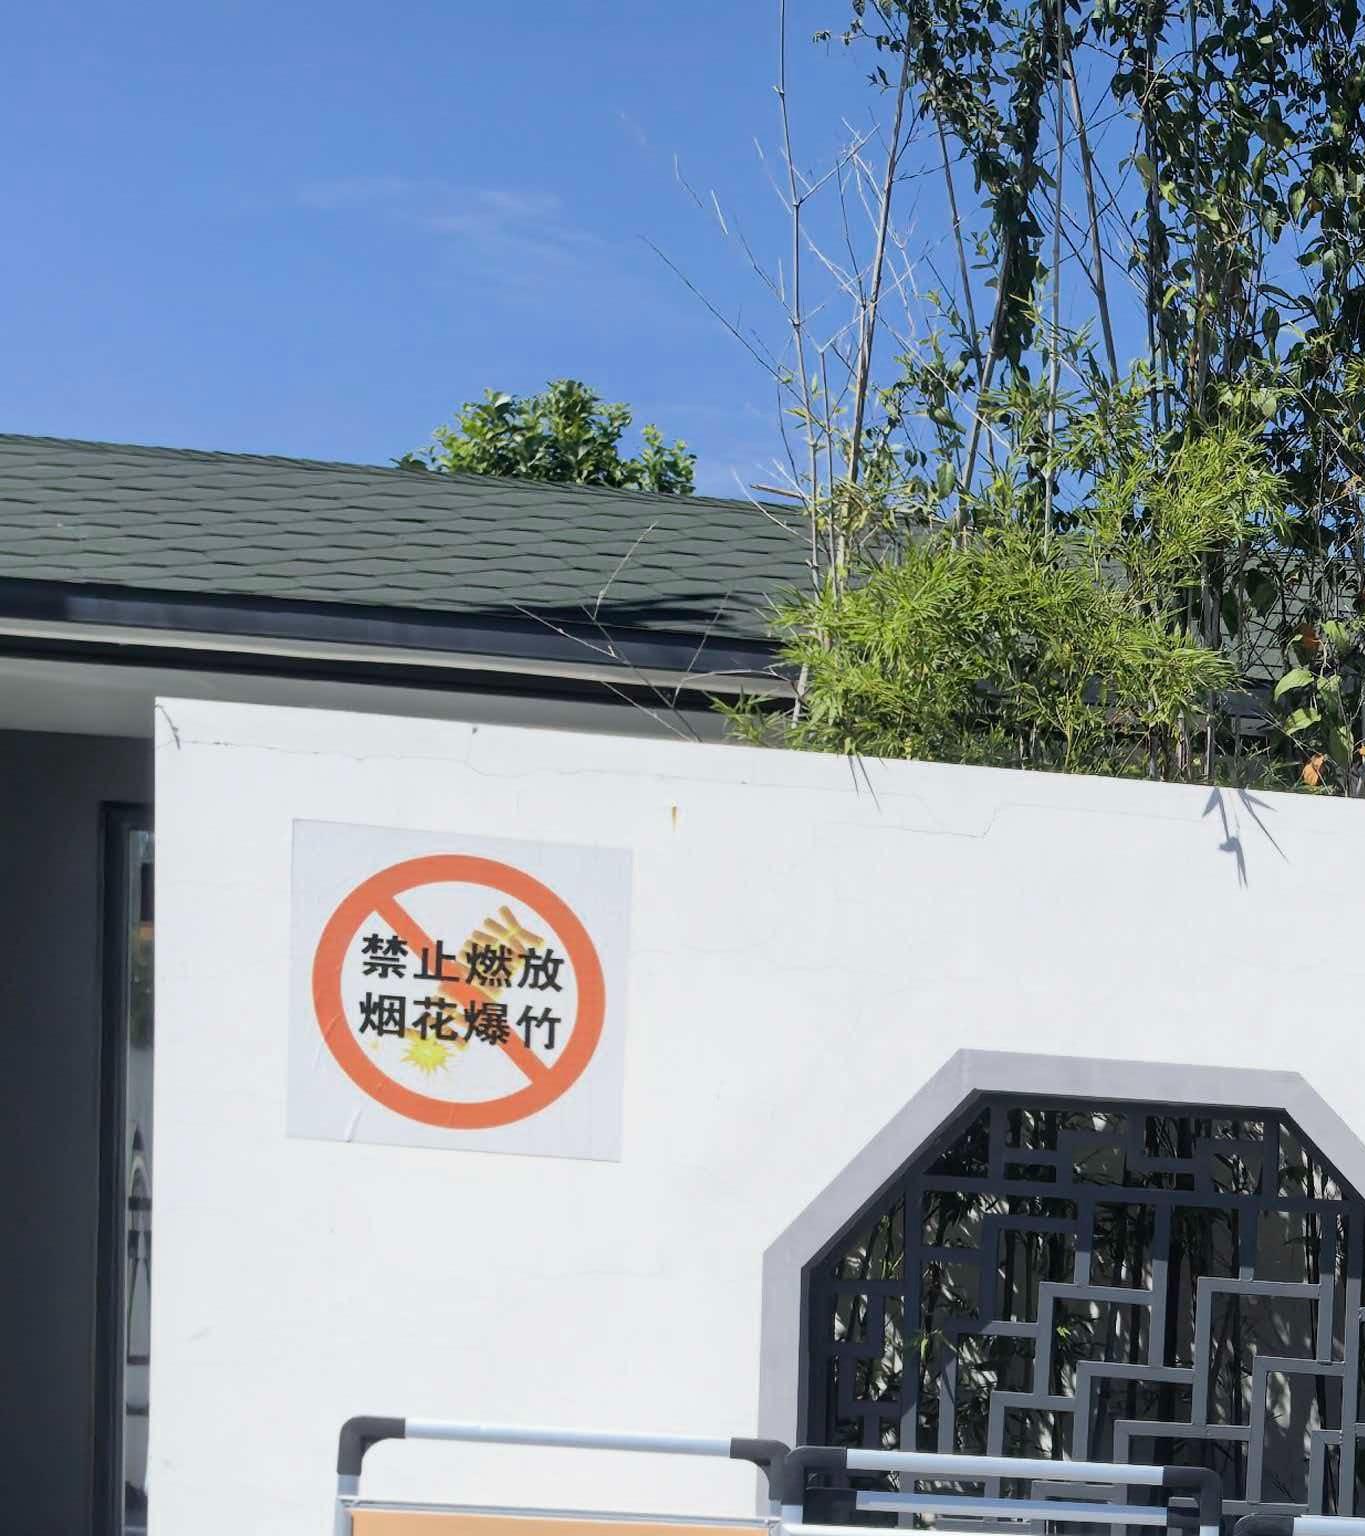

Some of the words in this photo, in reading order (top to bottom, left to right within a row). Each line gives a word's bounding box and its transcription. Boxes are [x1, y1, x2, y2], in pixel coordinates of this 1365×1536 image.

[360, 934, 565, 992] 禁止燃放
[358, 992, 562, 1050] 烟花爆竹
